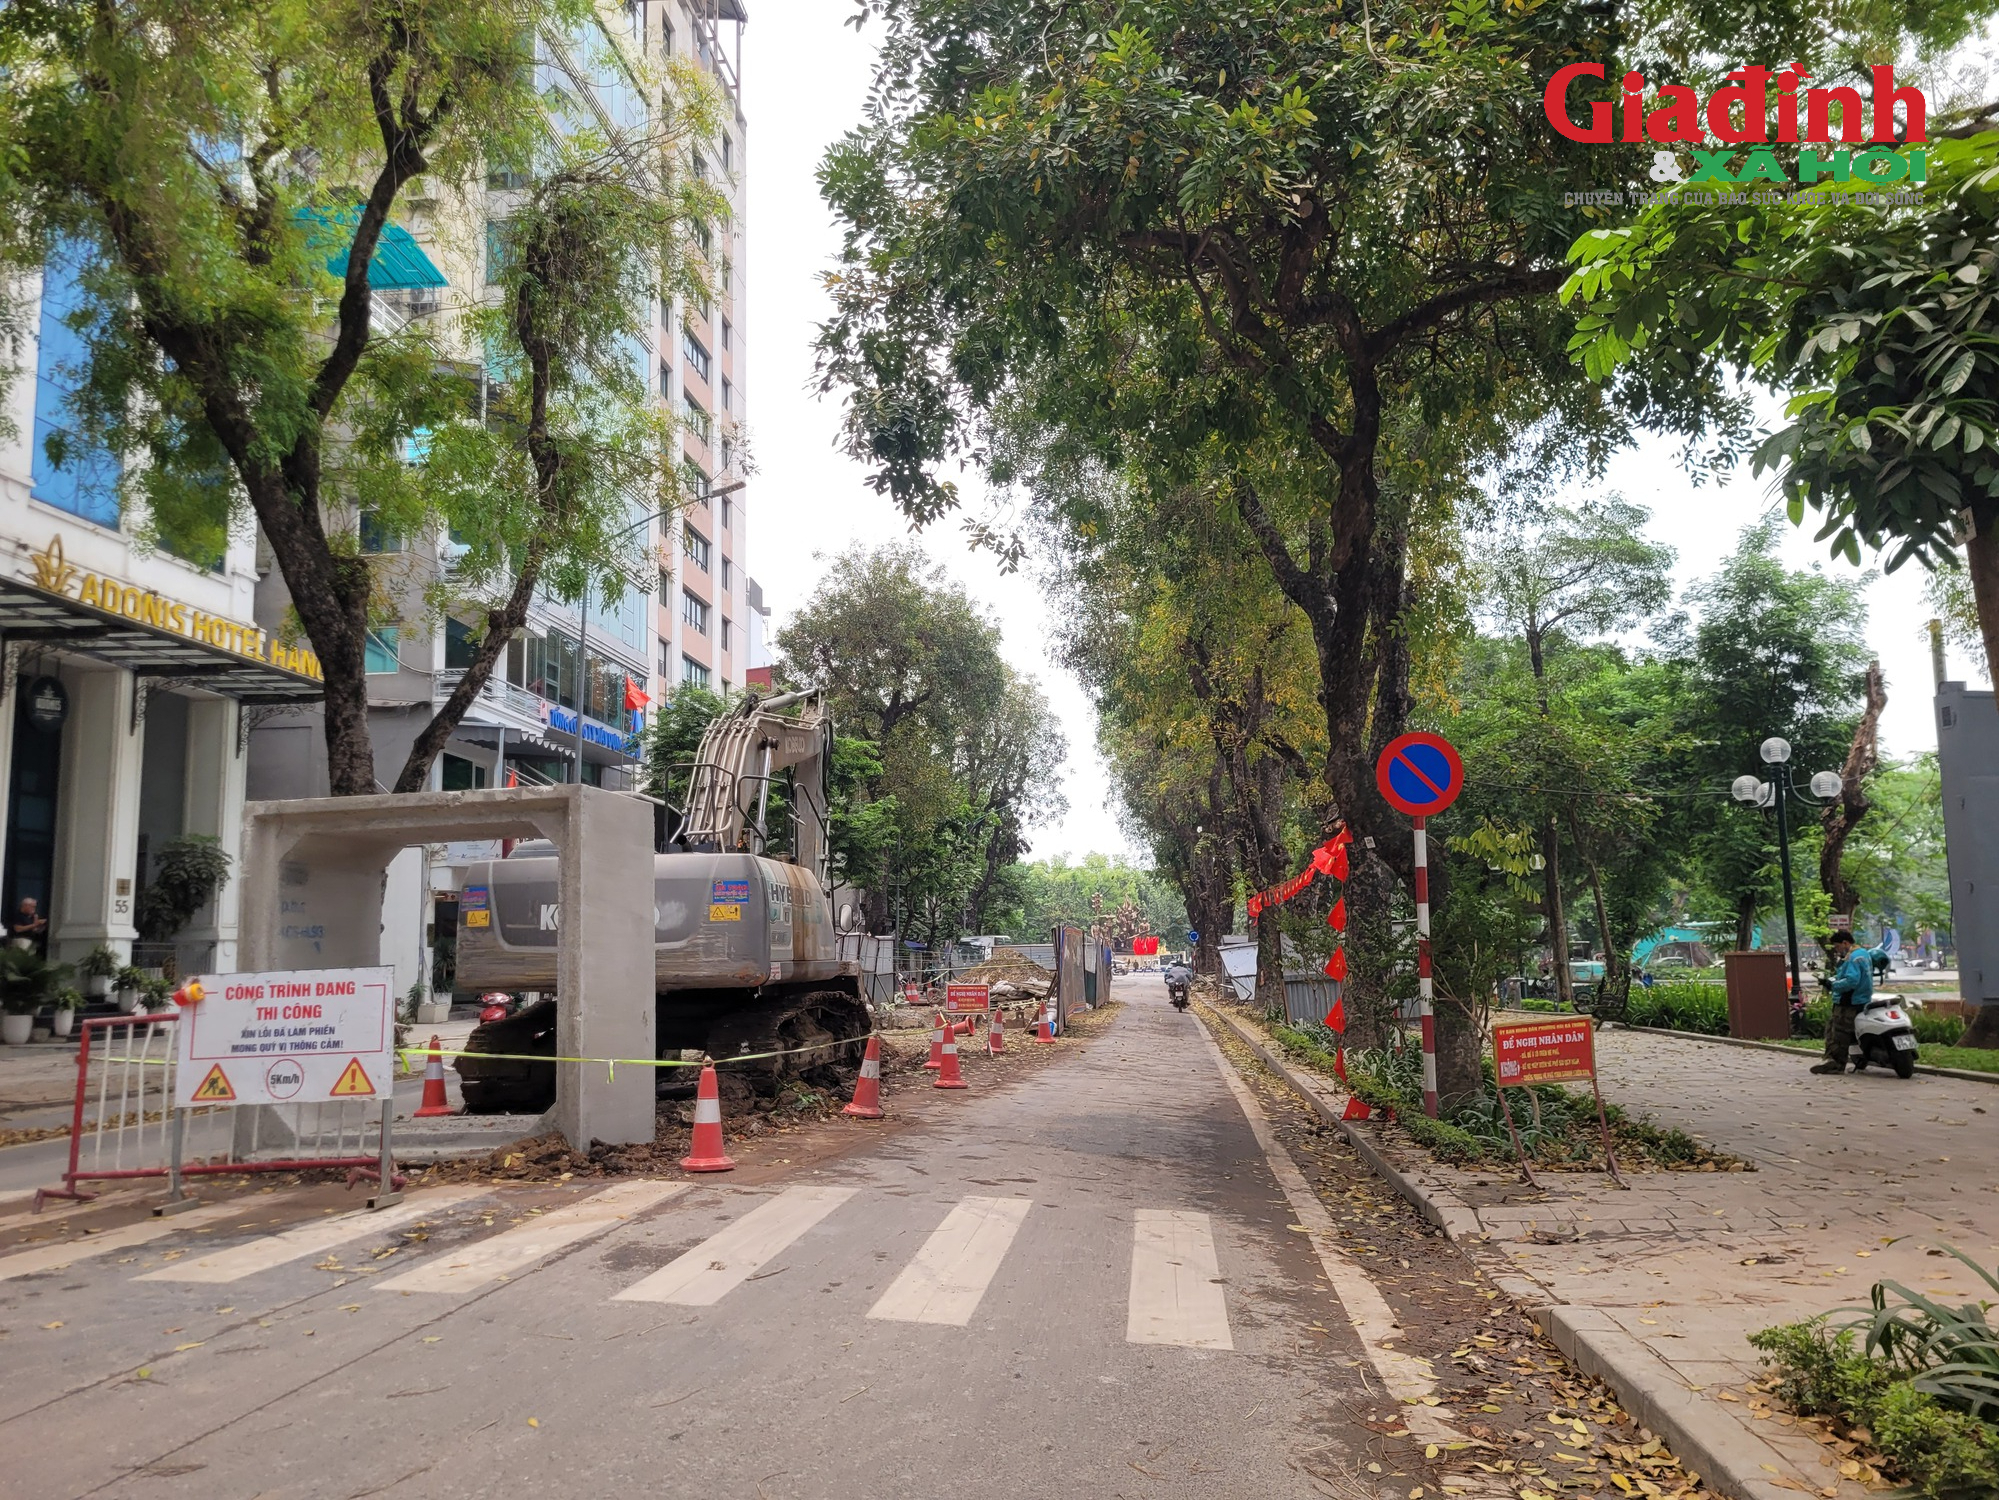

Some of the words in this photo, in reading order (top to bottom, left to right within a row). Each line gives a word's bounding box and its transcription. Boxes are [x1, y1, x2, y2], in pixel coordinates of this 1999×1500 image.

[79, 572, 187, 635] ADONIS
[192, 610, 266, 662] HOTEL
[114, 900, 129, 914] 55
[225, 983, 265, 1001] CÔNG
[268, 981, 311, 999] TRÌNH
[315, 981, 356, 997] ĐANG
[256, 1006, 278, 1021] THI
[282, 1002, 322, 1020] CÔNG
[240, 1028, 256, 1039] XIN
[258, 1025, 272, 1038] LỖI
[273, 1026, 286, 1038] ĐÃ
[287, 1025, 307, 1037] LÀM
[308, 1024, 336, 1036] PHIỀN
[1516, 1036, 1537, 1048] NGHỊ
[1538, 1032, 1564, 1045] NHÂN
[1565, 1030, 1585, 1043] DÂN
[230, 1043, 257, 1054] MONG
[259, 1040, 276, 1053] QUÝ
[278, 1041, 288, 1053] VỊ
[289, 1039, 318, 1051] THÔNG
[320, 1037, 344, 1050] CẢM!
[269, 1074, 300, 1086] 5Km/h
